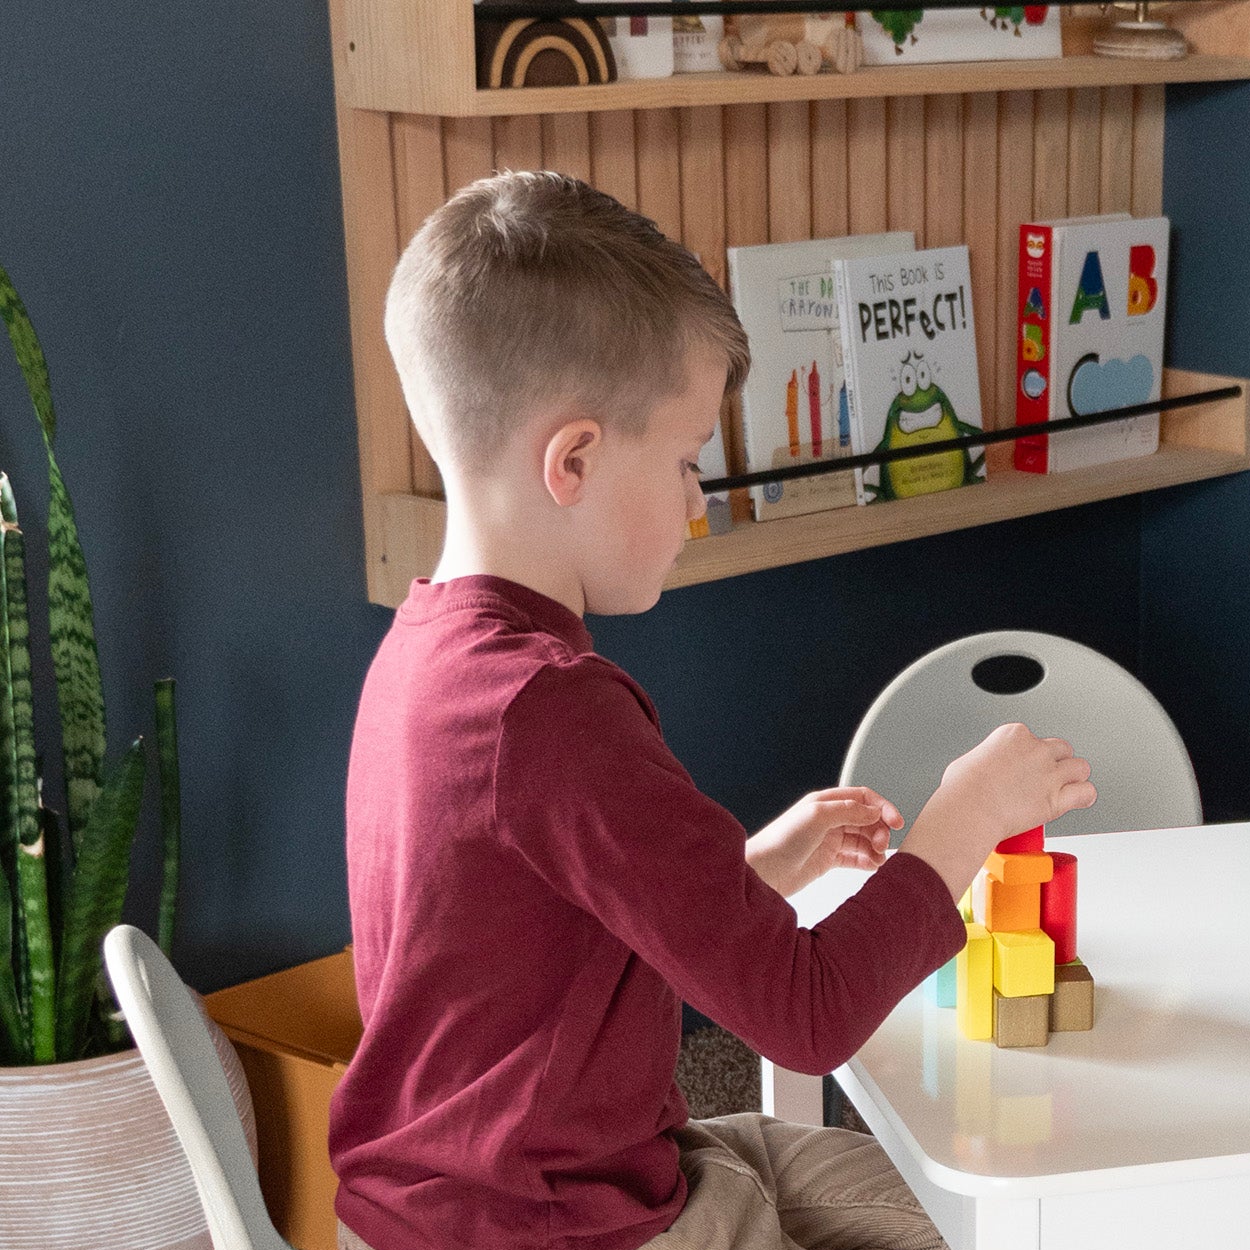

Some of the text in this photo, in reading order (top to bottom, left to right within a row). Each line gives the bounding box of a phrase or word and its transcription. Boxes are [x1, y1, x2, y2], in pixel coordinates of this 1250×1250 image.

[790, 280, 810, 296] THE
[820, 277, 834, 299] DA
[1069, 245, 1158, 326] A B
[1023, 287, 1046, 319] A
